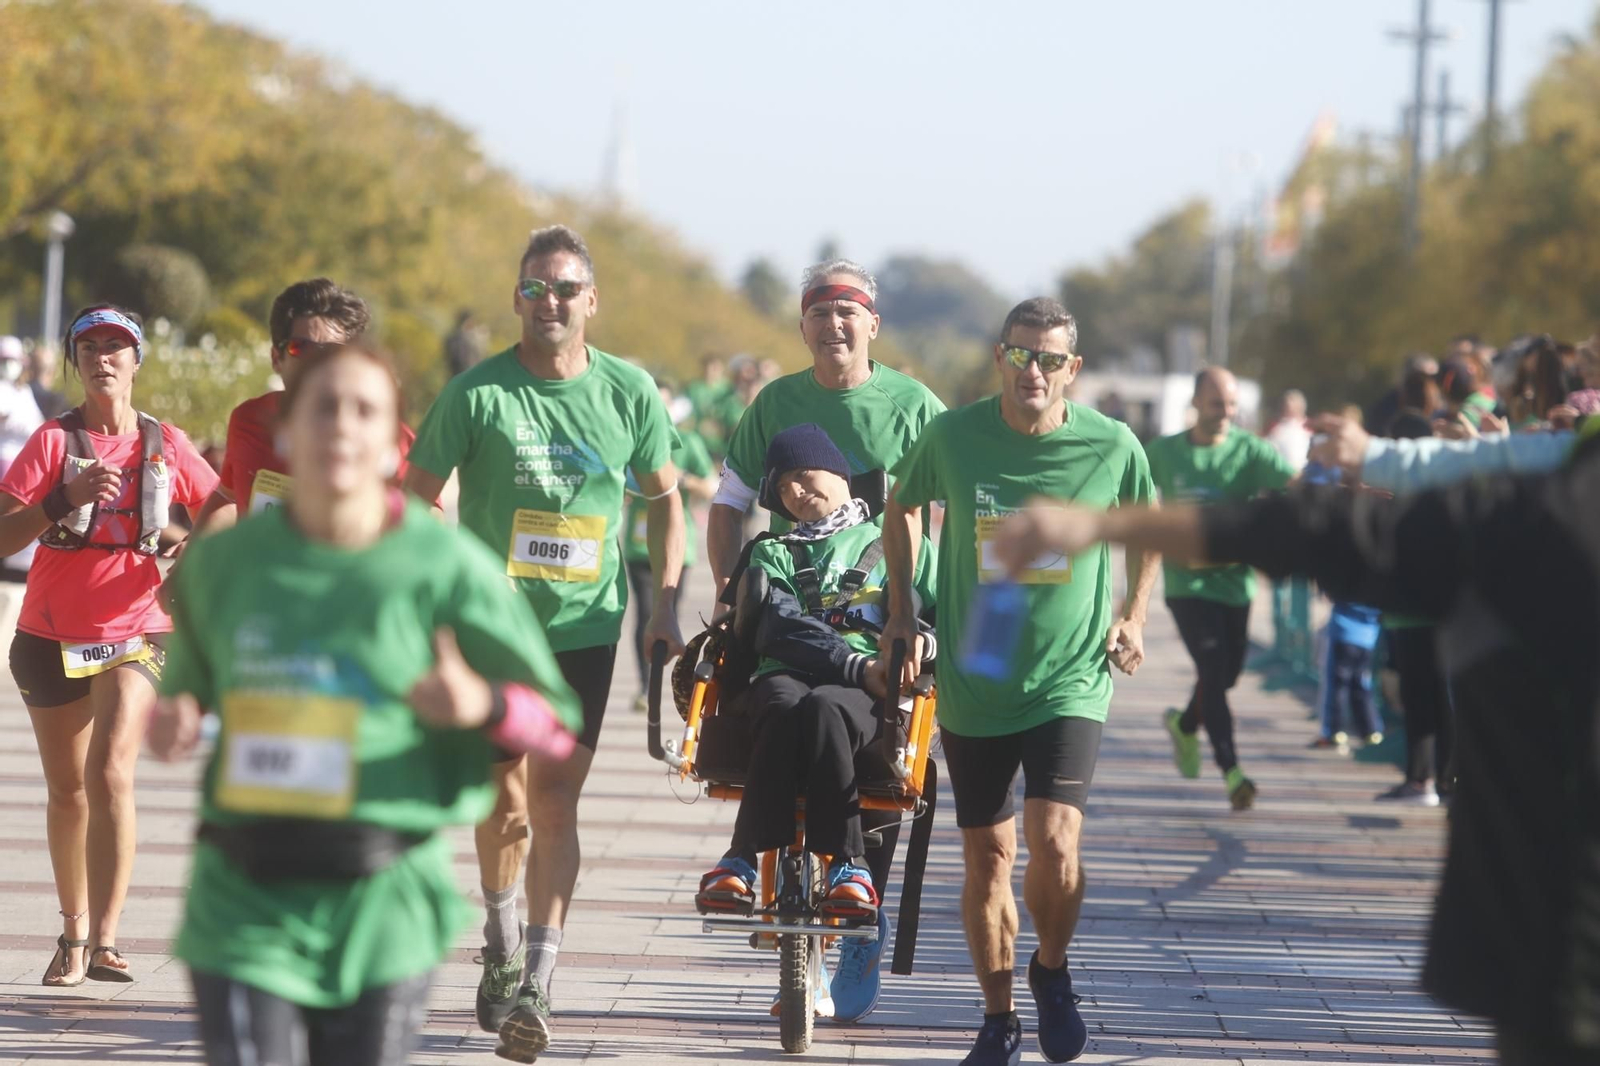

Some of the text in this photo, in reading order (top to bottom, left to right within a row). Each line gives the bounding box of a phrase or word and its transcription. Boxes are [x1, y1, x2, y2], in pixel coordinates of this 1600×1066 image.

[516, 427, 535, 440] En
[516, 443, 573, 456] marcha
[515, 458, 563, 471] contra
[514, 472, 584, 486] el cáncer
[975, 490, 995, 504] En
[528, 540, 570, 560] 0096
[82, 644, 116, 662] 0097
